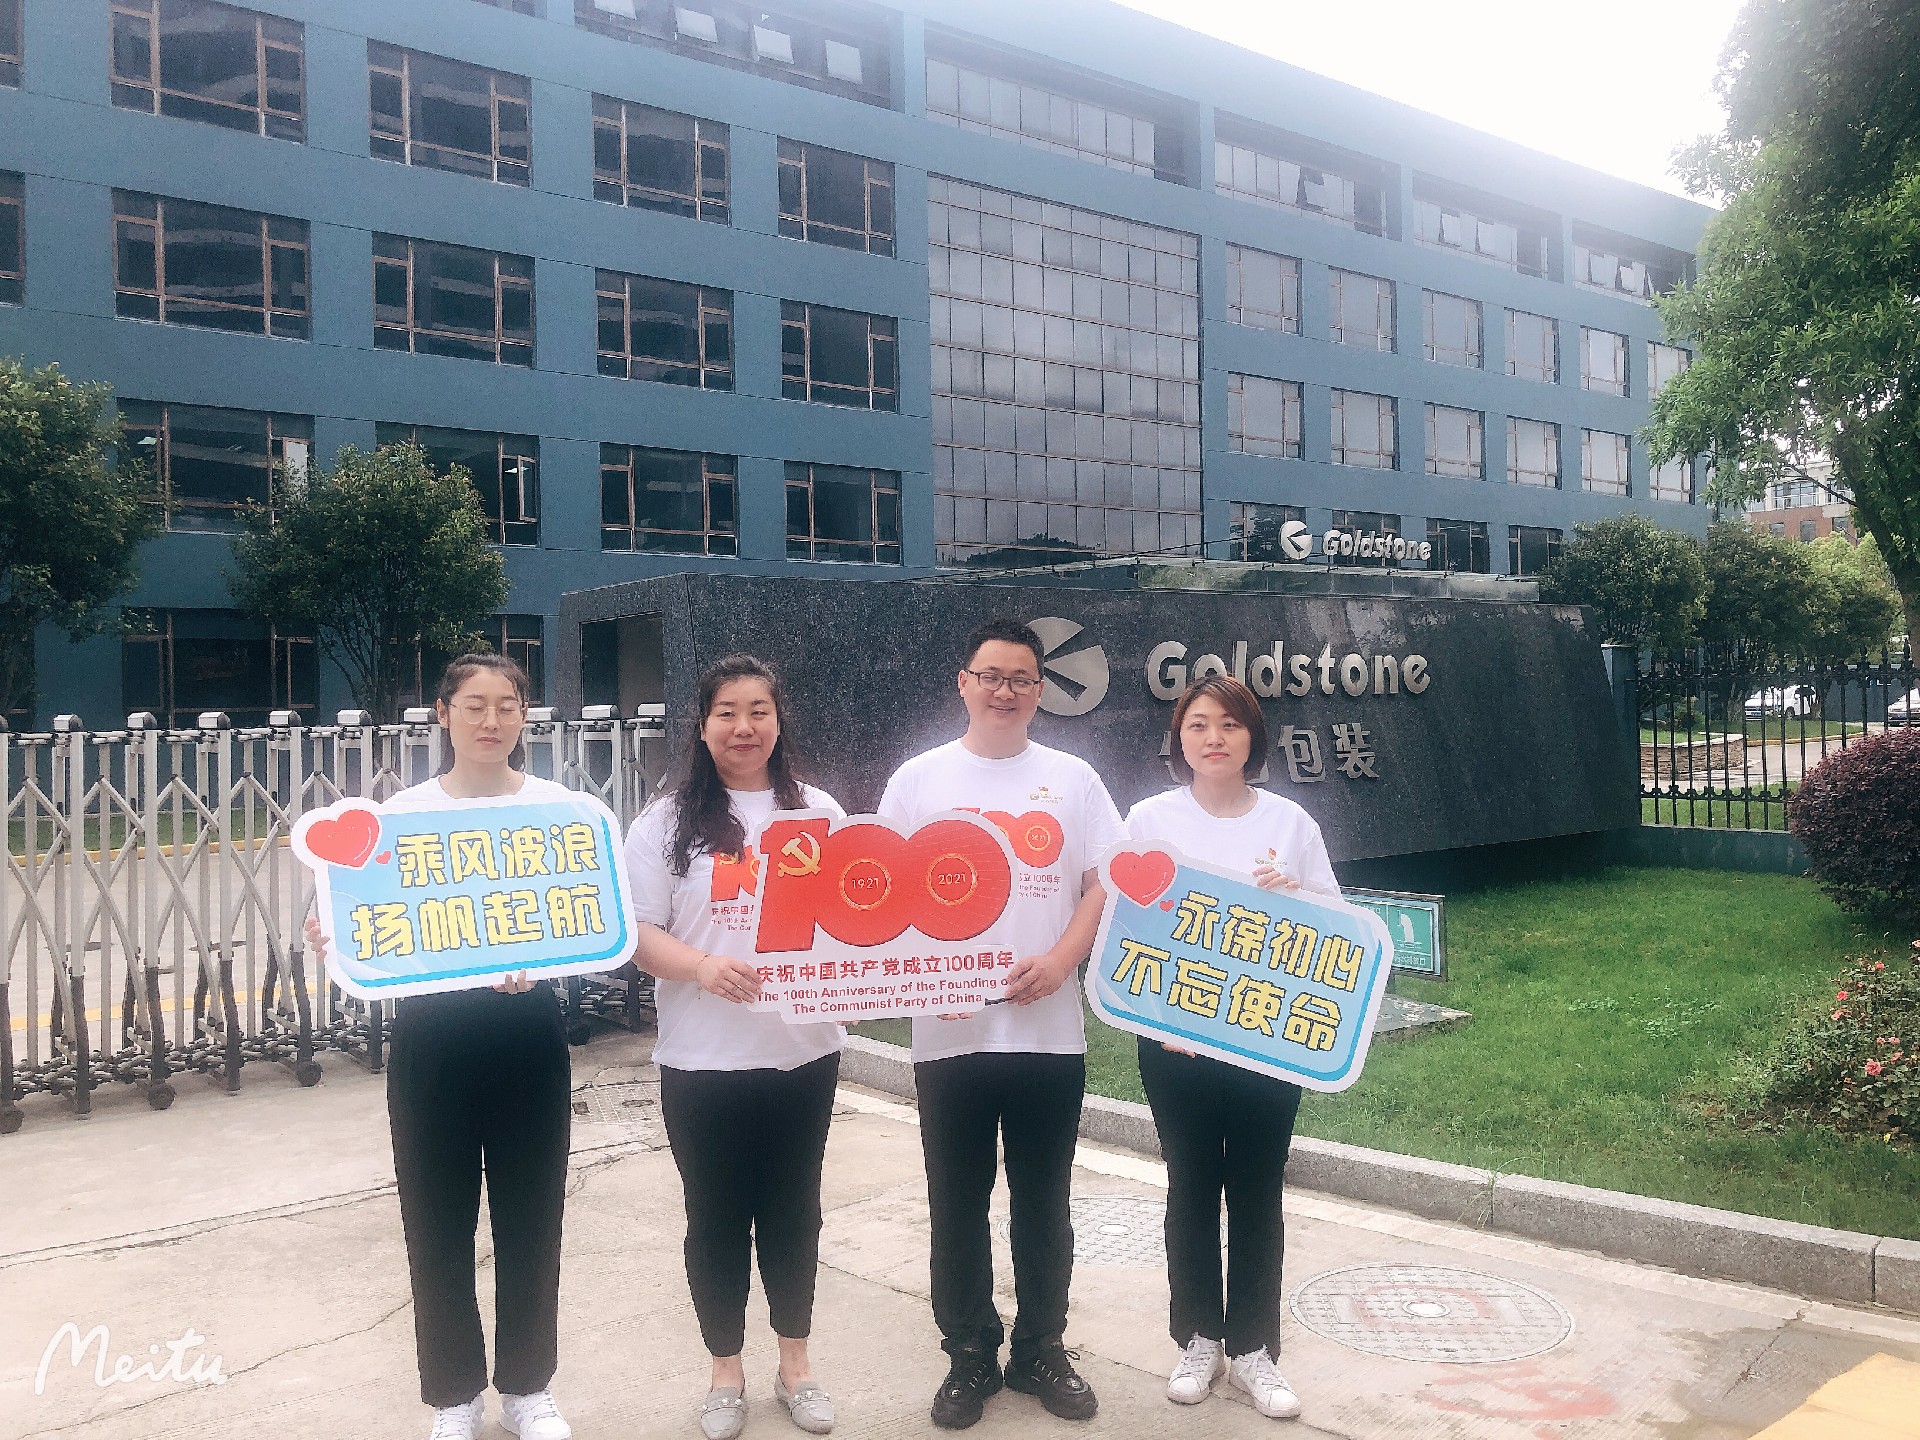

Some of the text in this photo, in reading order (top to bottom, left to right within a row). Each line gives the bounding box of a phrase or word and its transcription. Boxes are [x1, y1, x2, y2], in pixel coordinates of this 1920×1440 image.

[1323, 530, 1432, 561] Goldstone
[395, 822, 601, 888] 乘风波浪
[851, 877, 880, 891] 1921
[937, 872, 967, 886] 2021
[350, 883, 606, 961] 扬帆起航
[1172, 890, 1365, 993] 永葆初心
[757, 950, 1015, 983] 庆祝中国共产党成立100周年
[783, 988, 818, 1000] 100th
[821, 985, 896, 998] Anniversary
[900, 981, 913, 993] of
[916, 980, 936, 992] the
[939, 977, 997, 991] Founding
[792, 992, 983, 1015] The Communist Party of China
[1111, 938, 1342, 1052] 不忘使命
